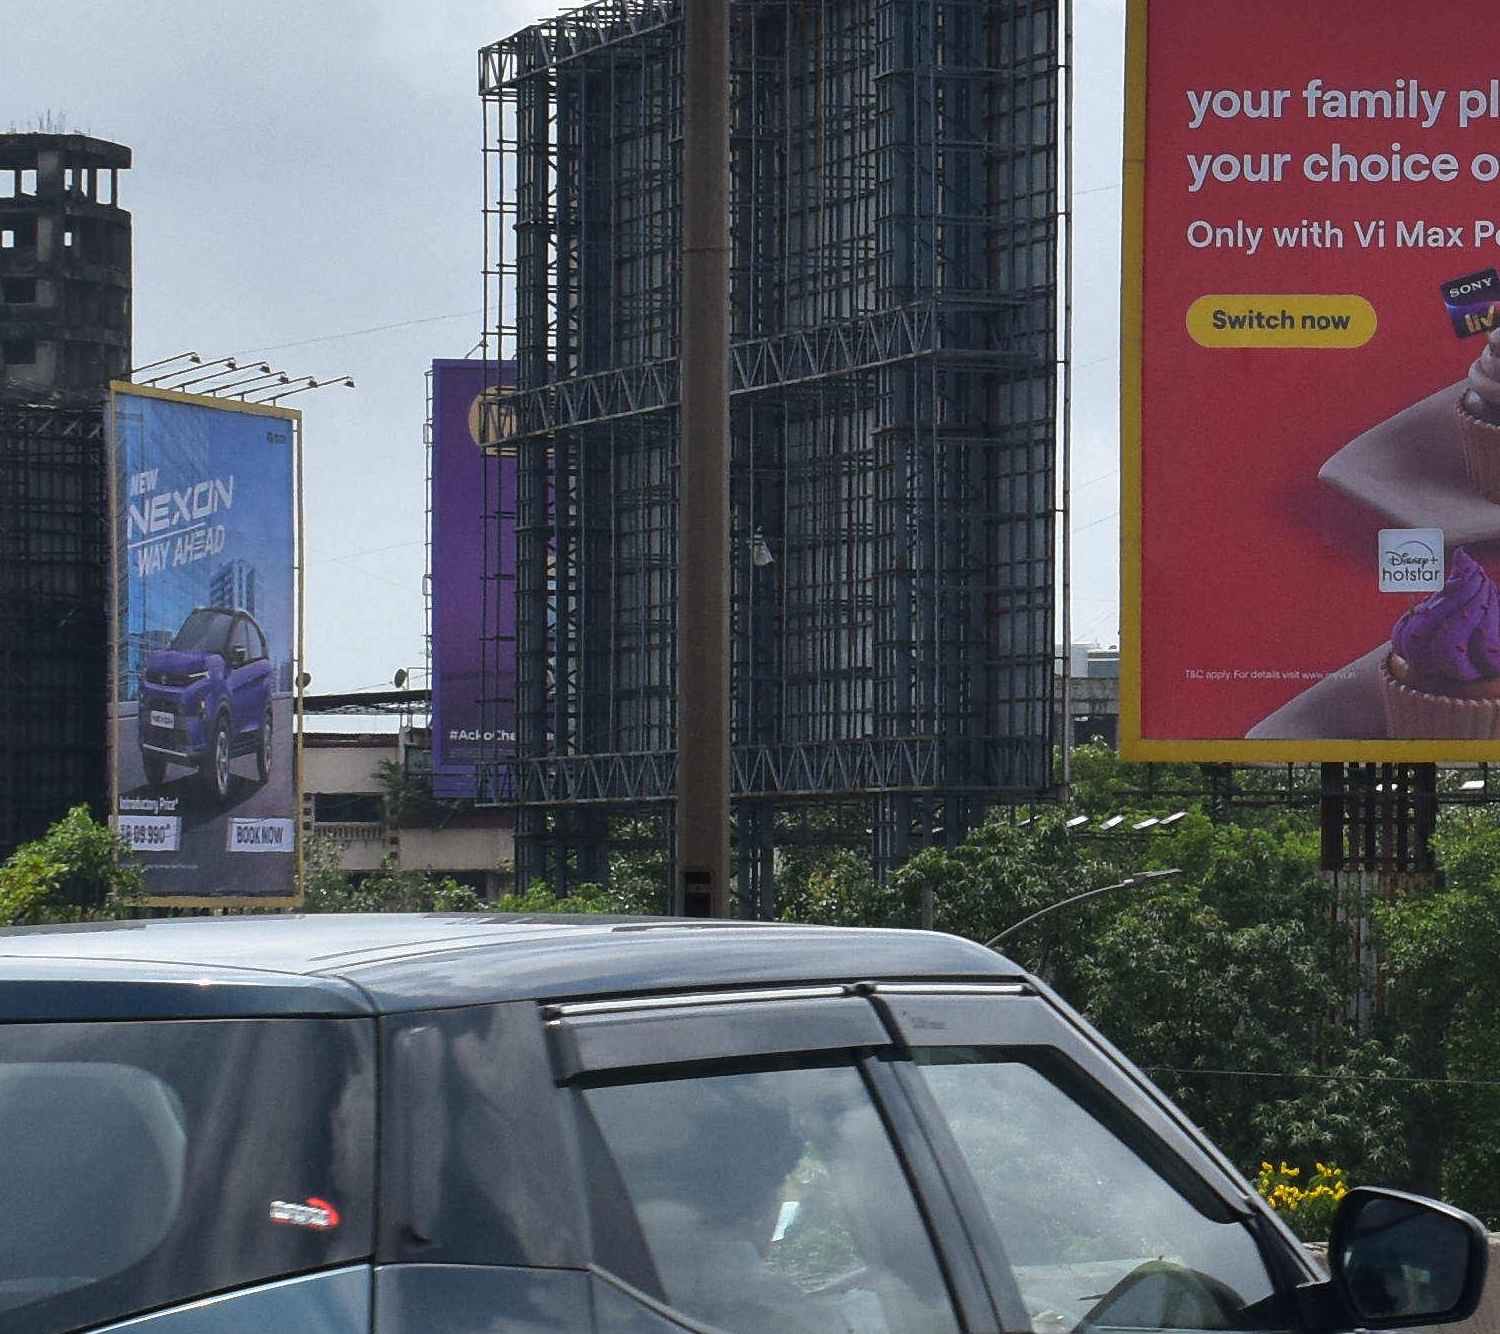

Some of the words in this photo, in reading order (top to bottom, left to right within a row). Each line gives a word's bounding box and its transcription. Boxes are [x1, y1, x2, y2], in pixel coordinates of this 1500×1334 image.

[1186, 90, 1291, 129] your
[1302, 79, 1446, 128] family
[1186, 153, 1291, 193] your
[1303, 142, 1459, 182] choice
[1187, 220, 1264, 255] Only
[1272, 220, 1344, 248] with
[1353, 220, 1386, 248] Vi
[1396, 221, 1464, 248] Max
[1449, 277, 1493, 299] SONY
[1211, 309, 1295, 330] Switch
[1301, 314, 1351, 330] now
[130, 468, 159, 497] NEW
[127, 475, 235, 540] NEXON
[137, 539, 171, 578] WAY
[173, 525, 226, 567] AHEAD
[1382, 567, 1440, 581] hotstar
[1234, 669, 1248, 679] For
[236, 826, 262, 844] BOOK
[262, 826, 283, 844] NOW
